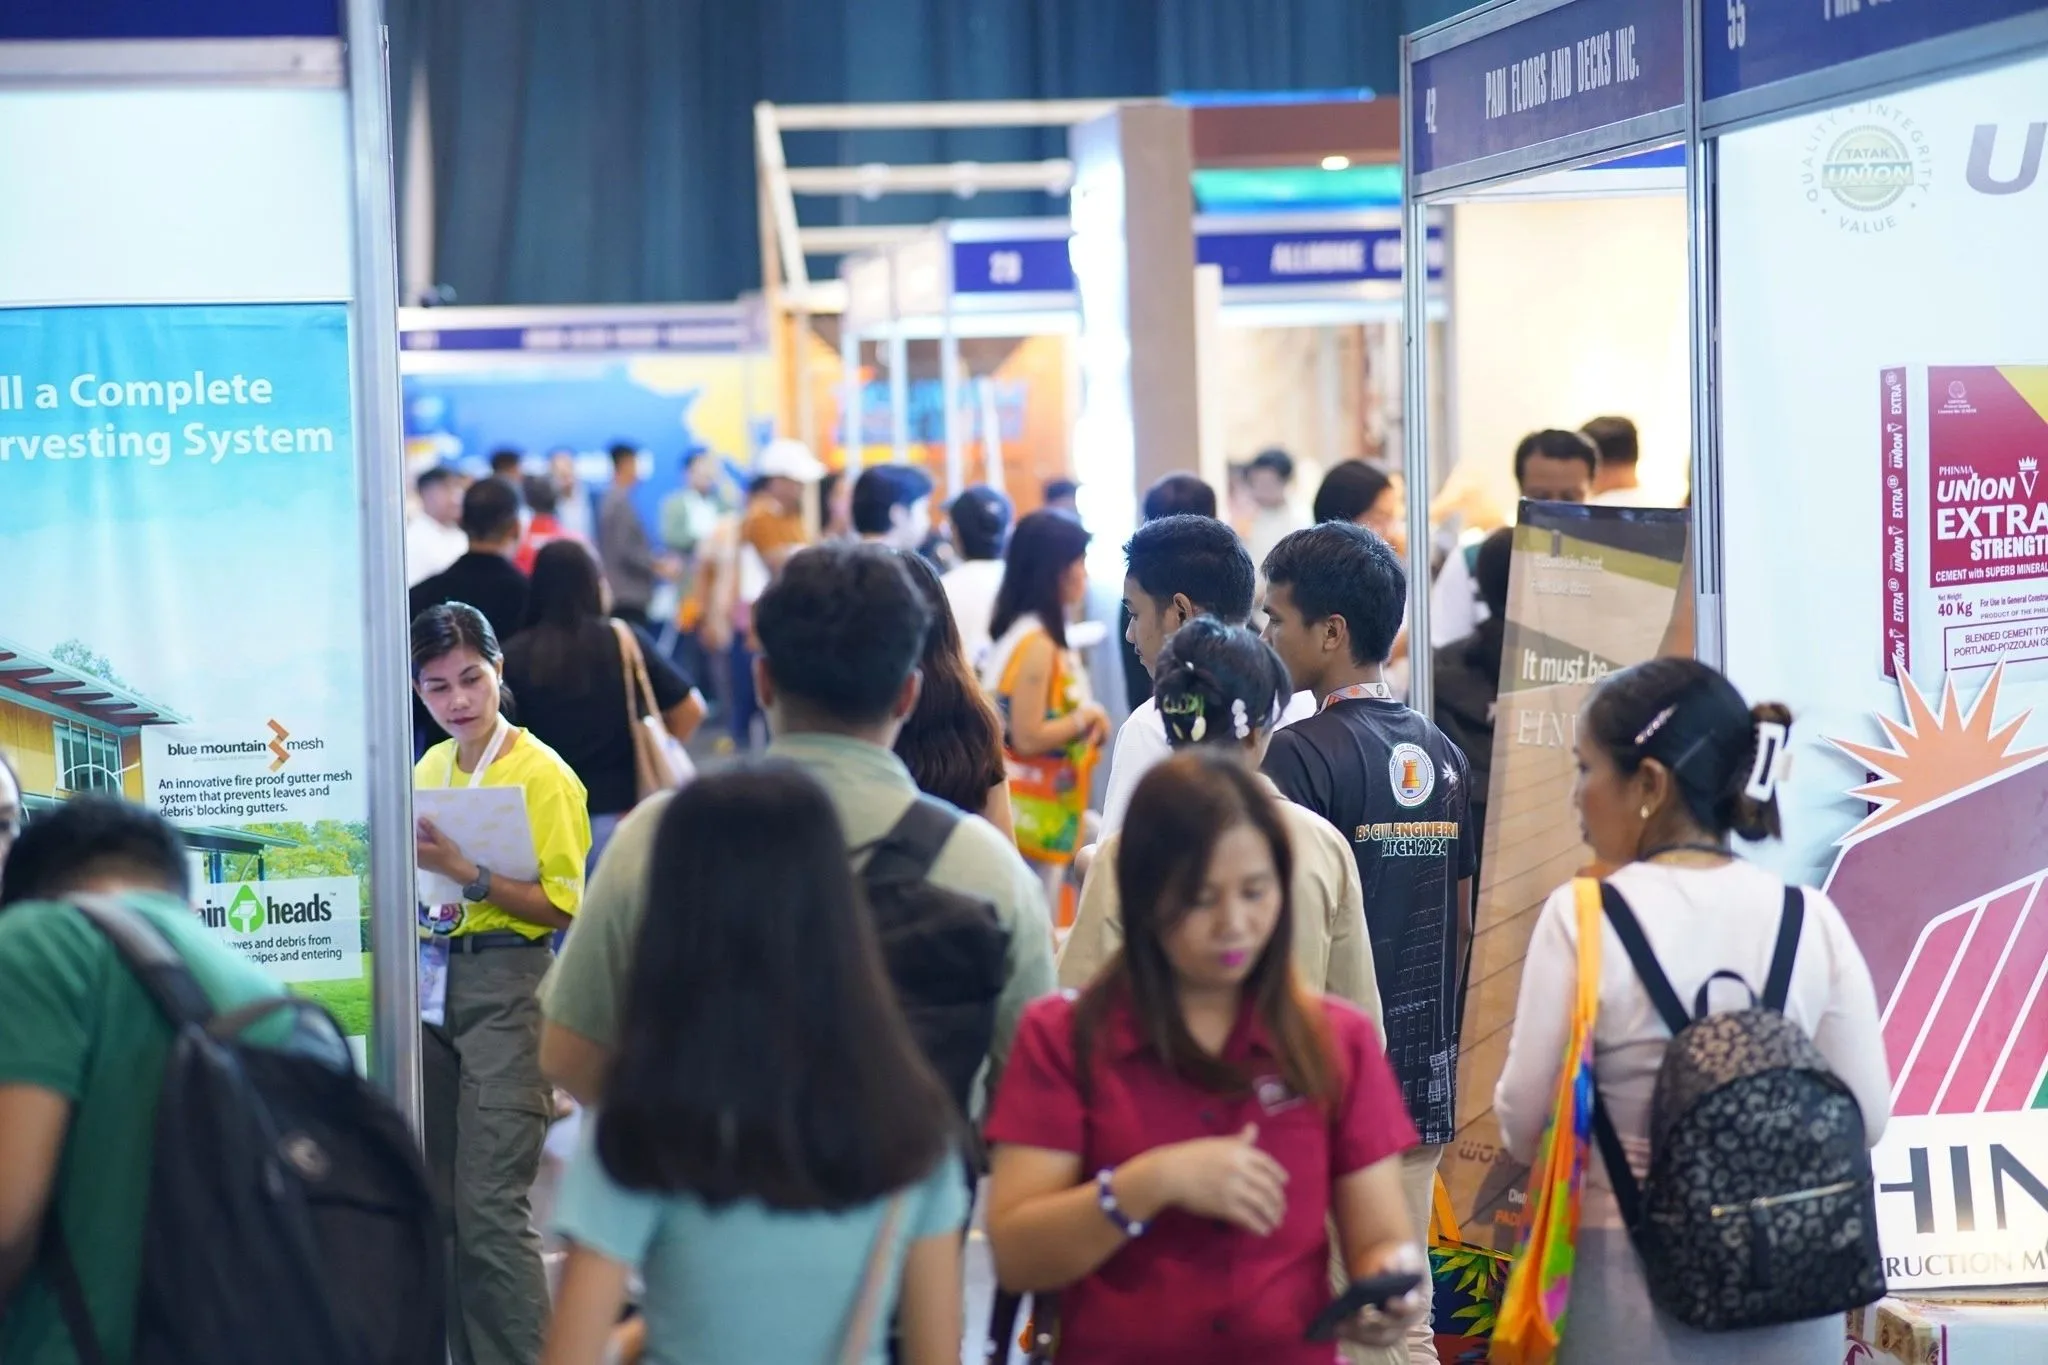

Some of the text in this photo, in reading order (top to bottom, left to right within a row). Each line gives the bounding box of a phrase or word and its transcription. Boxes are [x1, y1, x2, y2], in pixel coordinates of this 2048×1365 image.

[1425, 24, 1640, 134] 42 PADI FLOORS AND DECKS INC.
[1845, 147, 1890, 160] TATAK
[1827, 163, 1911, 187] UNION
[1839, 215, 1897, 234] VALUE
[35, 383, 58, 409] a
[69, 371, 273, 414] Complete
[0, 422, 333, 465] rvesting System
[1939, 465, 1974, 476] PHINMA
[1937, 472, 2016, 503] UNION
[1892, 488, 1903, 518] EXTRA
[1970, 534, 2048, 562] STRENGT
[1935, 568, 1967, 582] CEMENT
[1968, 567, 1984, 579] with
[1985, 564, 2016, 578] SUPERB
[1893, 592, 1904, 623] EXTRA
[1938, 601, 1973, 617] 40 Kg
[2007, 595, 2027, 604] General
[1980, 611, 2009, 619] PRODUCT
[1965, 631, 2001, 643] BLENDED
[2002, 628, 2033, 639] CEMENT
[1953, 640, 2039, 656] PORTLAND-POZZOLAN
[1522, 648, 1537, 680] It
[1540, 655, 1584, 684] must
[168, 738, 324, 756] blue mountain mesh
[159, 770, 352, 789] An innovative fire proof gutter mesh
[160, 785, 330, 805] system that prevents leaves and
[197, 804, 244, 817] blocking
[246, 803, 288, 816] gutters.
[1418, 838, 1447, 856] 2024
[266, 893, 332, 924] heads
[254, 937, 273, 949] and
[275, 935, 306, 947] debris
[307, 934, 331, 946] from
[280, 949, 299, 961] and
[301, 947, 342, 961] entering
[1882, 1252, 2013, 1278] RUCTION
